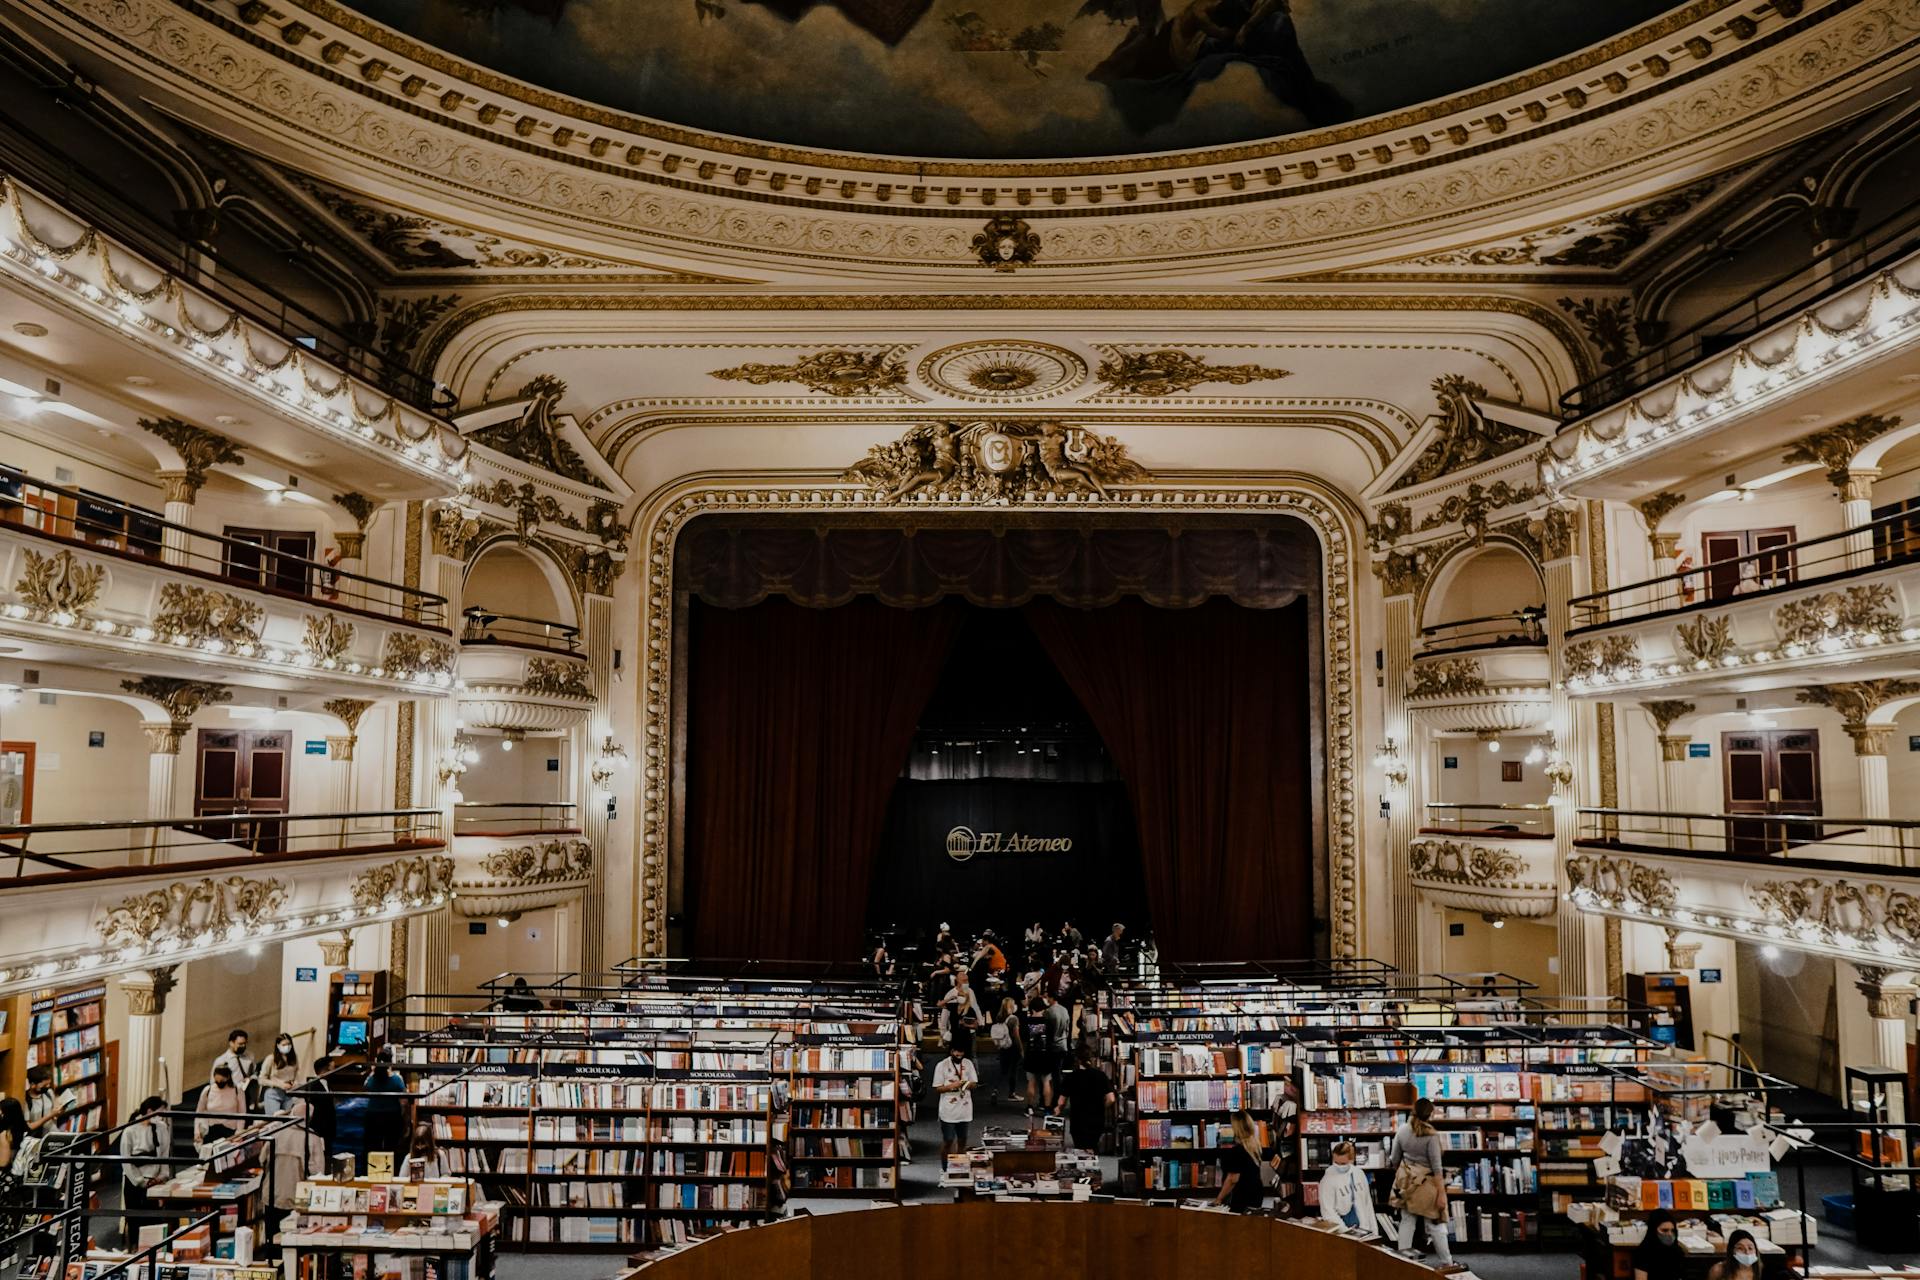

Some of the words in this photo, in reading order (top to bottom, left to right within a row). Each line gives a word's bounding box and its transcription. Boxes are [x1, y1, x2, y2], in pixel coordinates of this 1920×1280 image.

[976, 832, 1002, 853] El
[1003, 832, 1072, 853] Ateneo
[1157, 1033, 1175, 1041] ARTE
[1175, 1033, 1214, 1041] ARGENTINO
[575, 1067, 621, 1075] SOCIOLOGIA
[1450, 1065, 1484, 1073] TURISMO
[1565, 1065, 1599, 1074] TURISMO
[690, 1071, 736, 1079] SOCIOLOGIA
[68, 1170, 86, 1254] BIBLITECA
